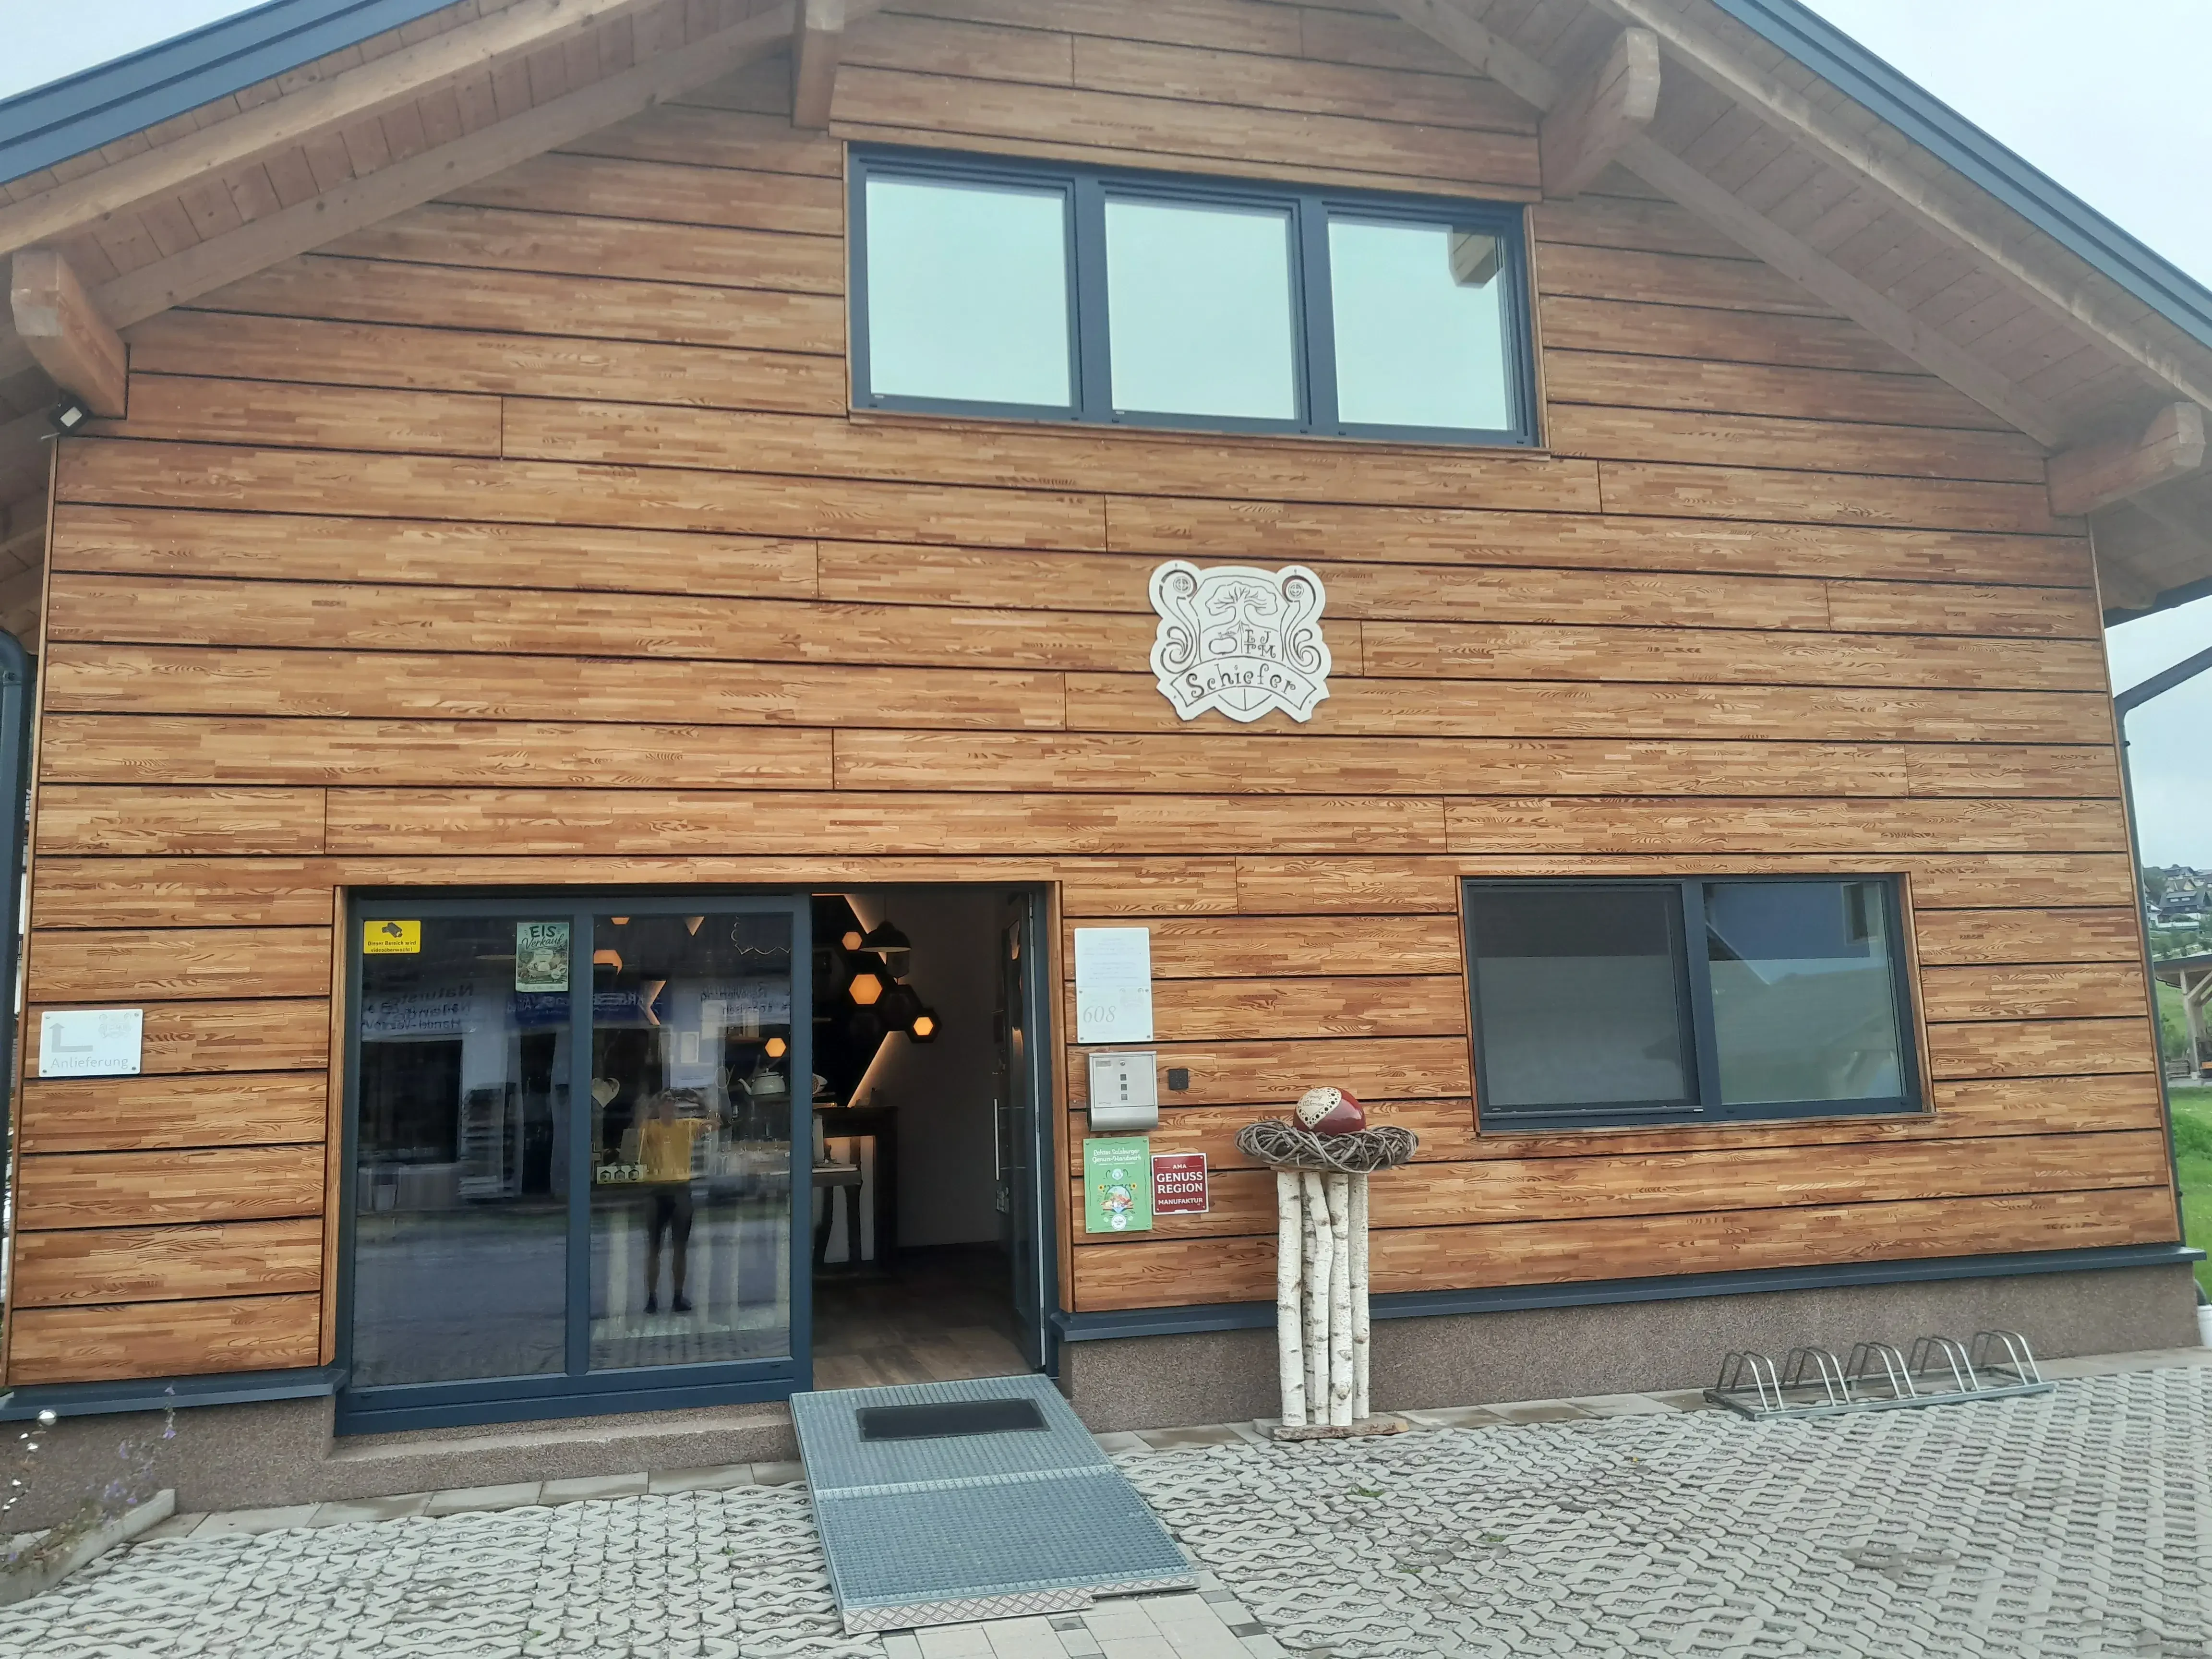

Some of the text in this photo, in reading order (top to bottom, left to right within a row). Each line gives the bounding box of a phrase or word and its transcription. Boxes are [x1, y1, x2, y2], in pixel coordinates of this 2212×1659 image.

[1186, 663, 1297, 698] Schiefer
[529, 925, 557, 938] EIS
[521, 933, 565, 950] Verkauf
[1083, 1005, 1117, 1023] 608
[50, 1056, 129, 1070] Anlieferung
[1093, 1147, 1140, 1156] Echtes Salzburger
[1092, 1154, 1142, 1164] Genuss-Handwerk
[1156, 1171, 1203, 1183] GENUSS
[1157, 1182, 1203, 1194] REGION
[1158, 1197, 1203, 1205] MANUFAKTUR
